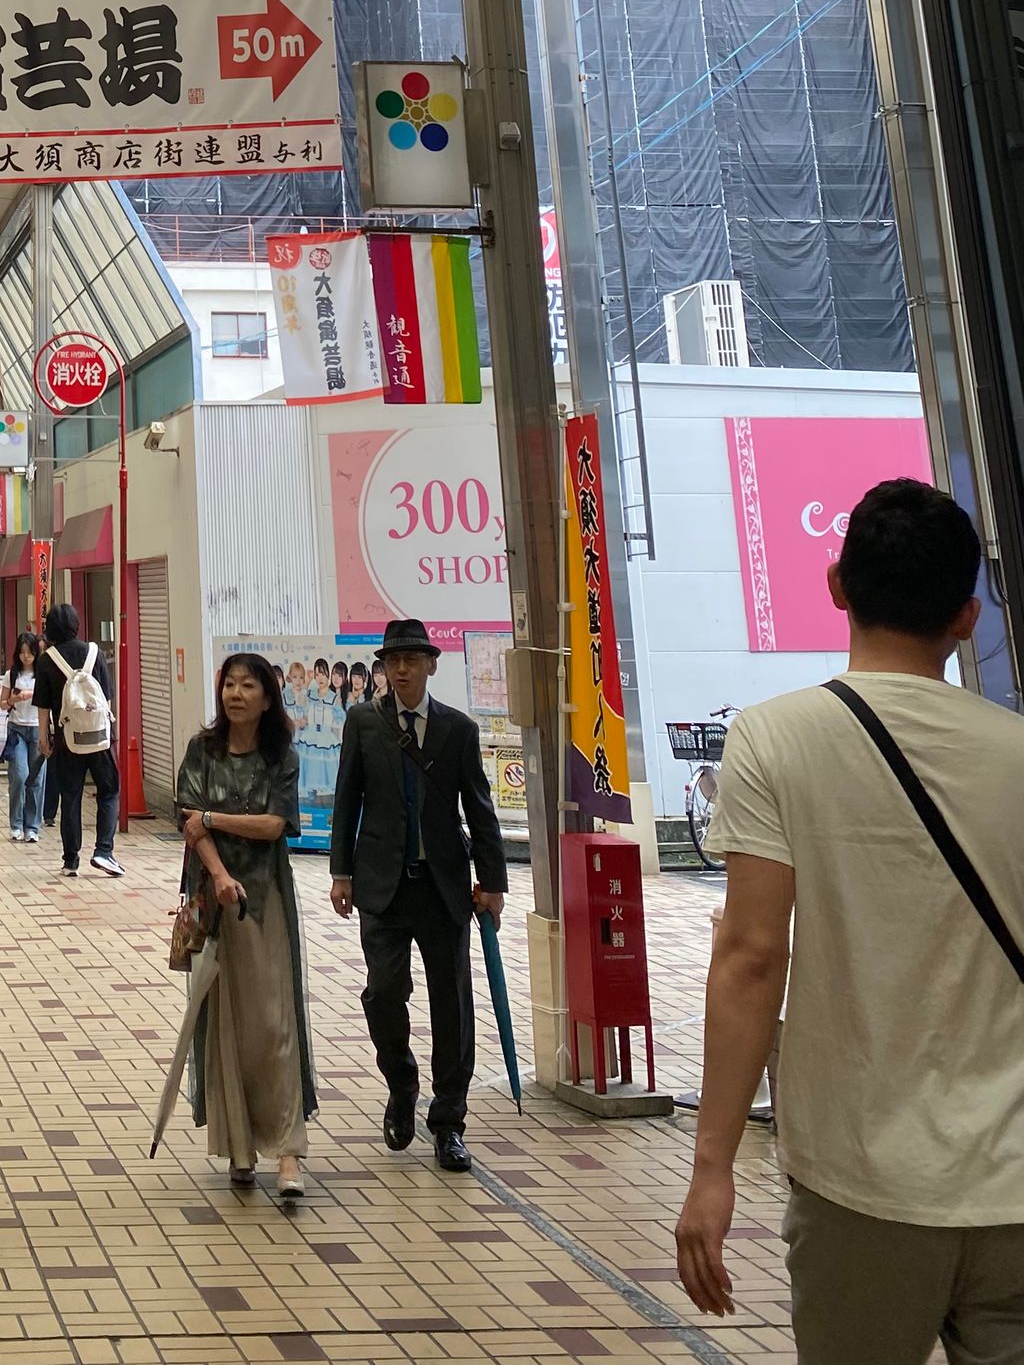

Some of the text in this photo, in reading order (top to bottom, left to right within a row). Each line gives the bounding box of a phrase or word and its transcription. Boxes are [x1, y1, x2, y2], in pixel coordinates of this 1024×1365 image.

[232, 27, 305, 64] 50m
[57, 351, 96, 359] FIRE HYDRANT
[52, 362, 103, 386] 消火栓
[609, 879, 625, 948] 消火器
